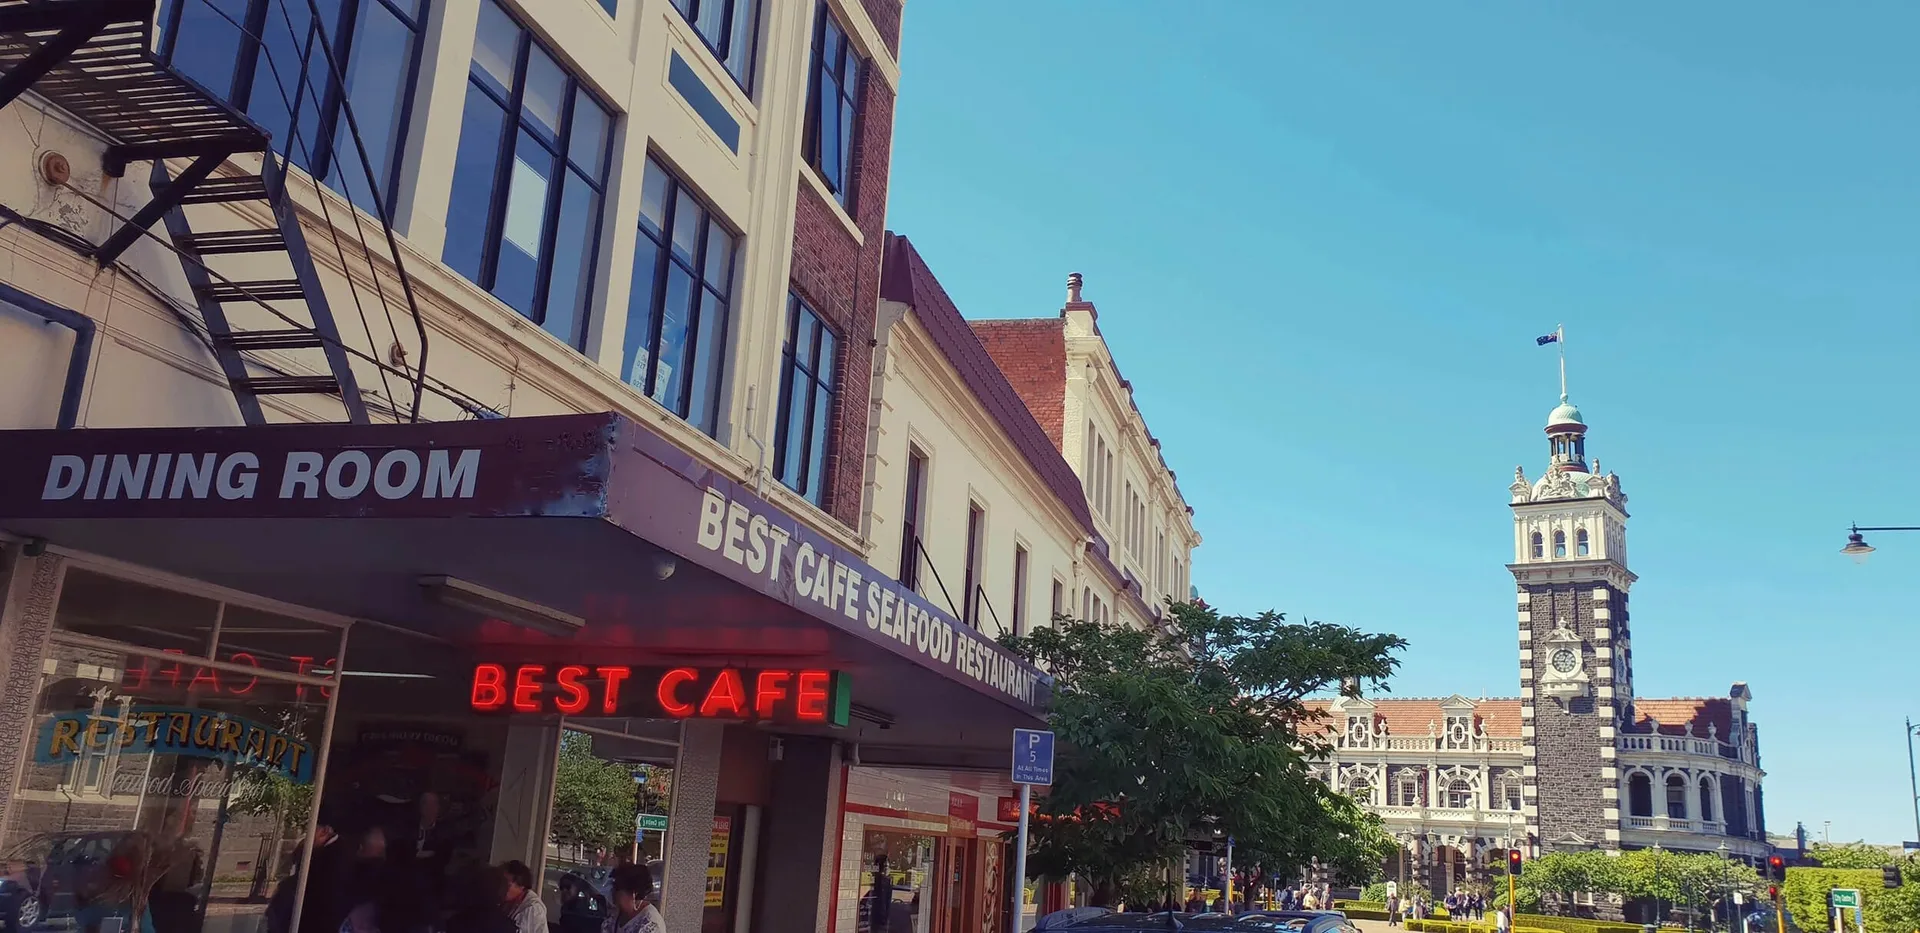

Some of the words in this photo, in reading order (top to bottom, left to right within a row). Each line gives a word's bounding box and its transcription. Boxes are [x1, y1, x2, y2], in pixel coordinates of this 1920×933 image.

[41, 452, 259, 500] DINING
[279, 449, 482, 499] ROOM
[697, 486, 790, 582] BEST
[795, 542, 863, 621] CAFE
[866, 581, 952, 665] SEAFOOD
[955, 631, 1038, 707] RESTAURANT
[472, 664, 630, 714] BEST
[657, 668, 831, 721] CAFE
[51, 711, 306, 773] RESTAURANT
[1029, 734, 1040, 749] P
[1030, 750, 1036, 762] 5
